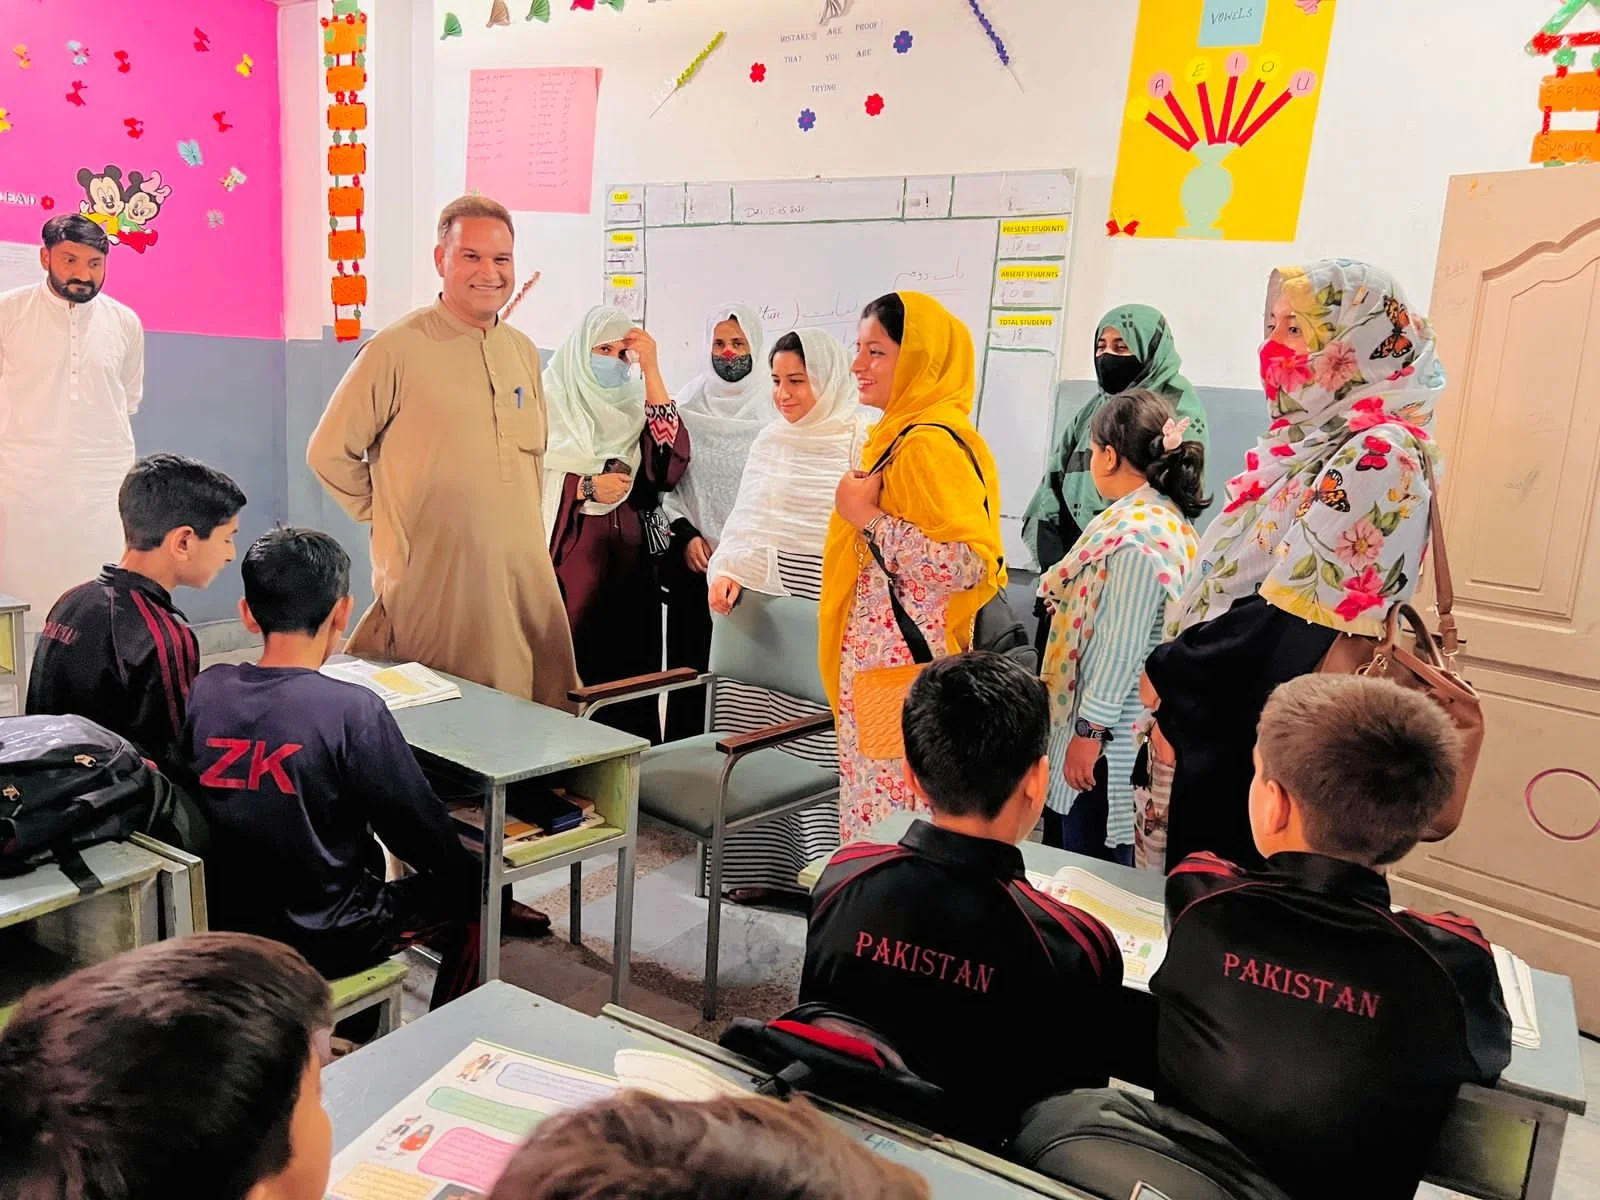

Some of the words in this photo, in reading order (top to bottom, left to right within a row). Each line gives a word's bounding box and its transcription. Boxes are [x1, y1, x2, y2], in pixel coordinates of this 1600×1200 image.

[1211, 8, 1253, 24] VOWELS
[1154, 78, 1165, 93] A
[1192, 63, 1205, 77] E
[1261, 61, 1275, 73] O
[1296, 77, 1310, 91] U
[1003, 225, 1030, 233] PRESENT
[1000, 270, 1025, 278] ABSENT
[1027, 270, 1058, 278] STUDENTS
[199, 737, 303, 795] ZK
[855, 930, 995, 994] PAKISTAN
[1223, 951, 1381, 1020] PAKISTAN
